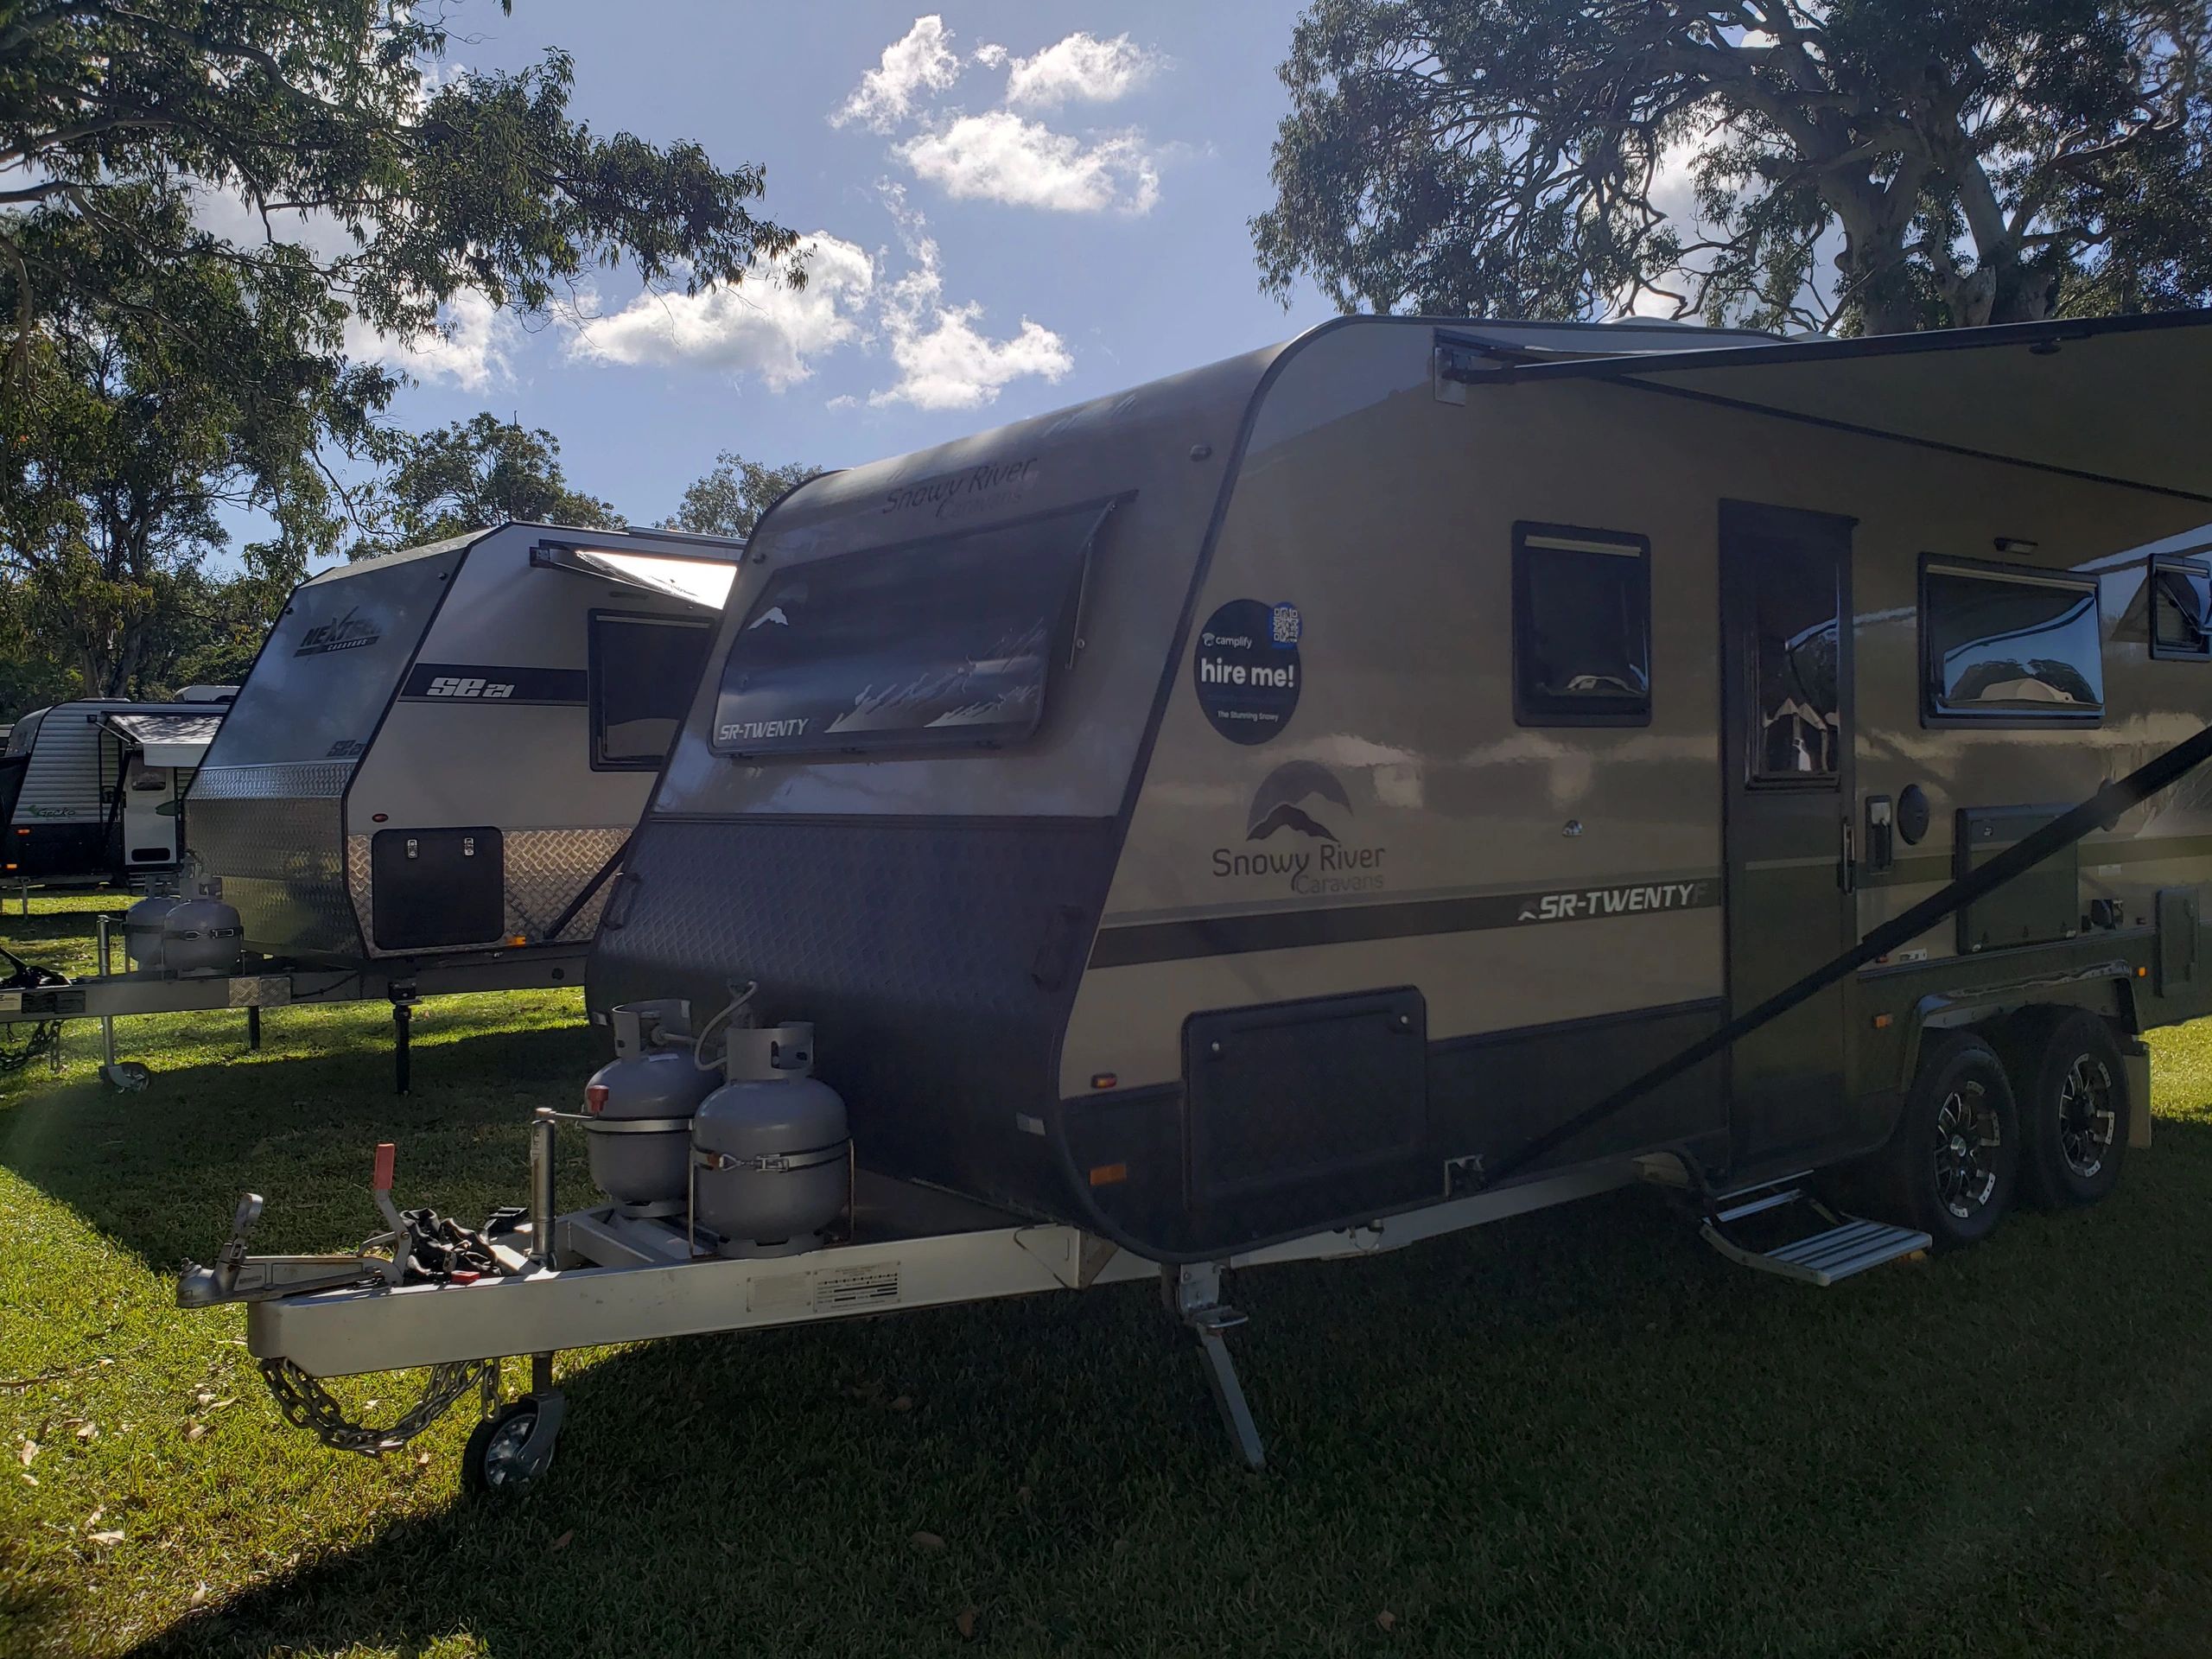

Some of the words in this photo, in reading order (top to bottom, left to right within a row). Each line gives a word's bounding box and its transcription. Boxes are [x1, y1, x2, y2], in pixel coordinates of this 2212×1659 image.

[882, 478, 964, 518] Snowy
[968, 457, 1038, 493] River
[1215, 636, 1252, 650] camplify
[1200, 657, 1246, 684] hire
[1250, 664, 1294, 689] me!
[1217, 710, 1230, 720] The
[718, 717, 810, 741] SR-TWENTY
[1211, 848, 1310, 892] Snowy
[1319, 844, 1386, 872] River
[1295, 874, 1383, 895] Caravans
